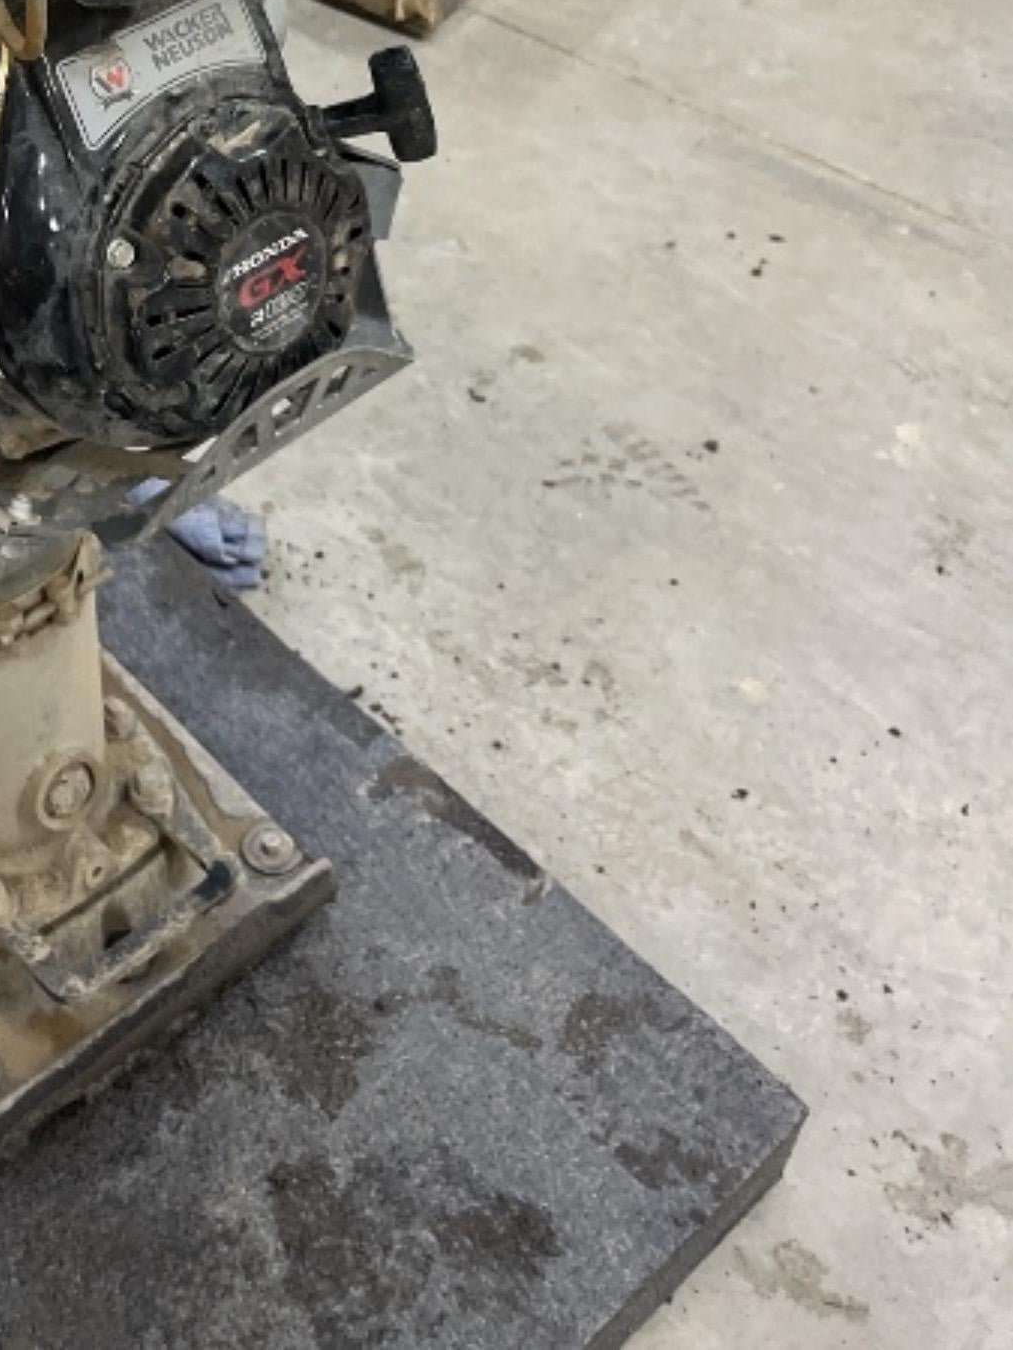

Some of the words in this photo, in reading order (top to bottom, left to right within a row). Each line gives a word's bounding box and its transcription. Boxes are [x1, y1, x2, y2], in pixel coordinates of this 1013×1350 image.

[142, 2, 228, 51] WACKER
[151, 14, 234, 72] NEUSON
[232, 227, 310, 280] HONDA
[236, 244, 308, 308] GX
